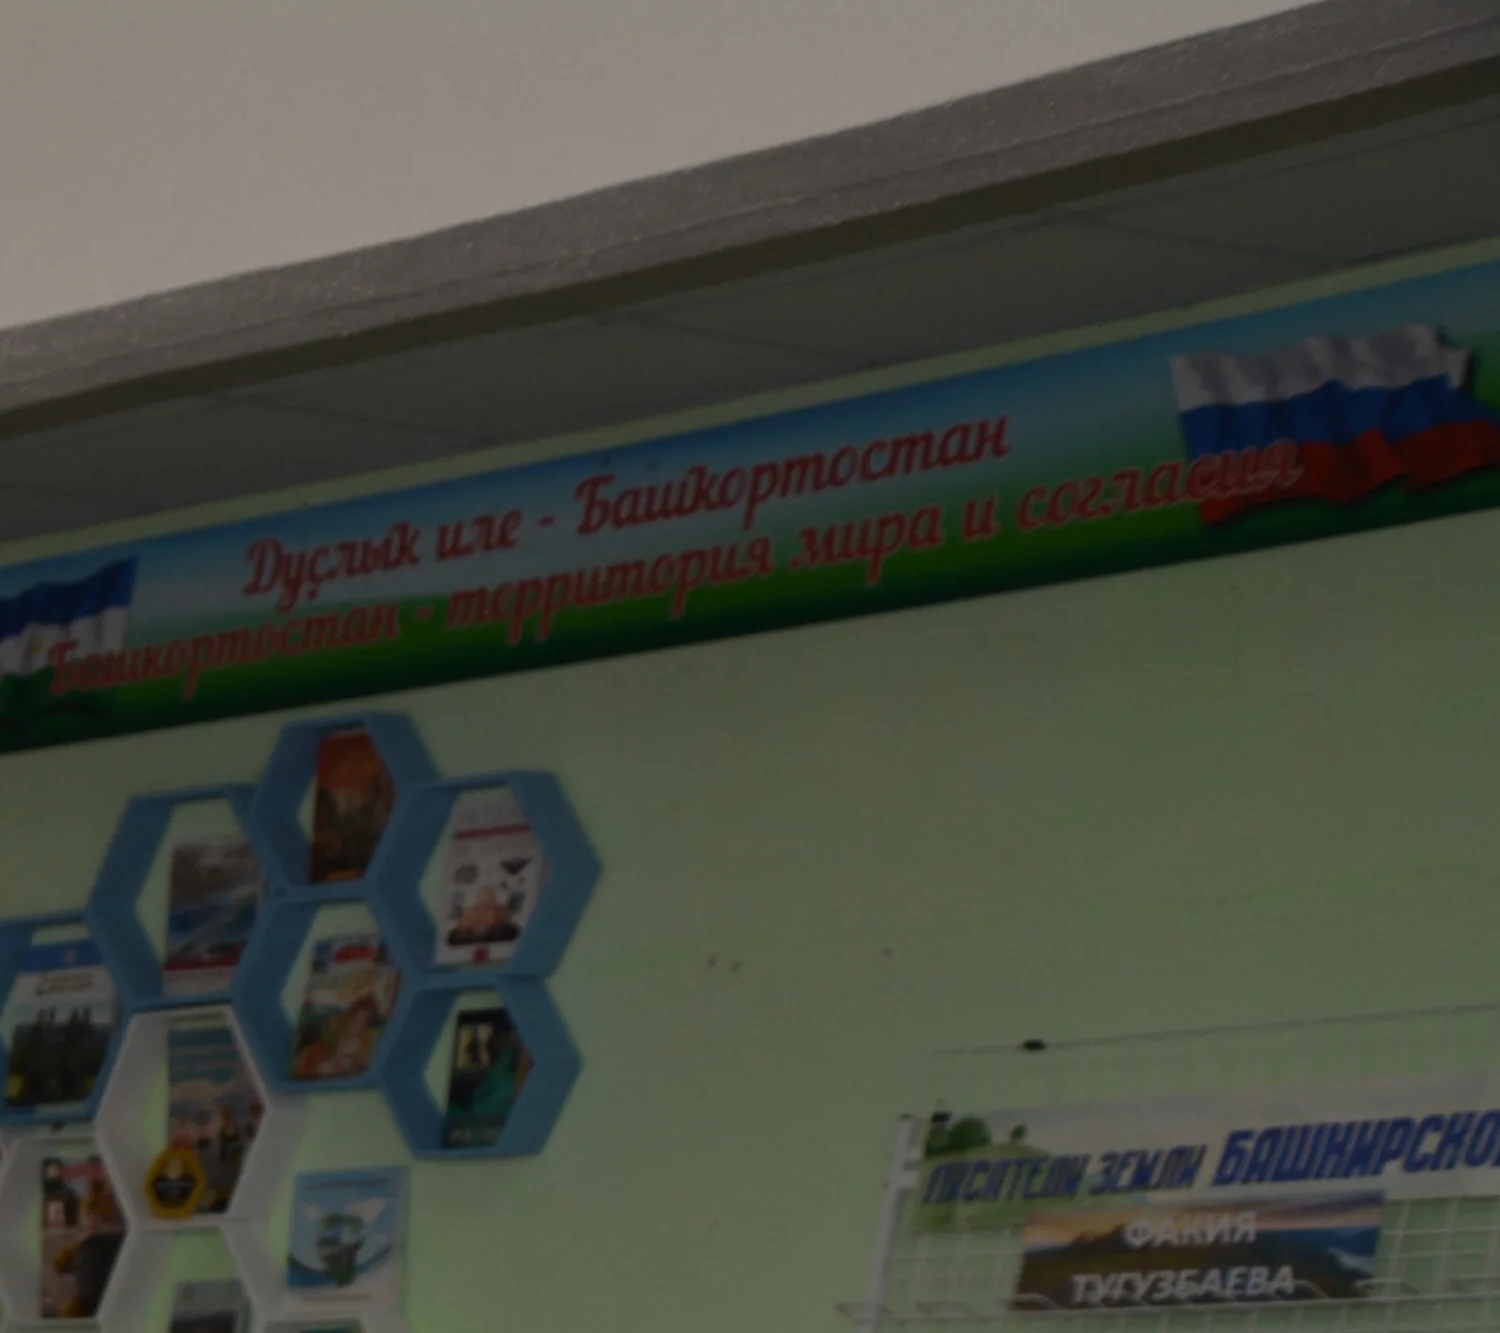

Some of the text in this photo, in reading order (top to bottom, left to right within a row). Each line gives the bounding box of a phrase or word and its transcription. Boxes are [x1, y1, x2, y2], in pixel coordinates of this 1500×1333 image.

[435, 505, 523, 562] иле
[47, 439, 1302, 701] Башкортостан территория мира и согласия
[922, 1154, 1088, 1205] ПИСАТЕЛИ
[1088, 1145, 1207, 1193] ЗЕМЛИ
[1124, 1212, 1259, 1249] ФАКИЯ
[1071, 1266, 1296, 1308] ТУГУЗБАЕВА
